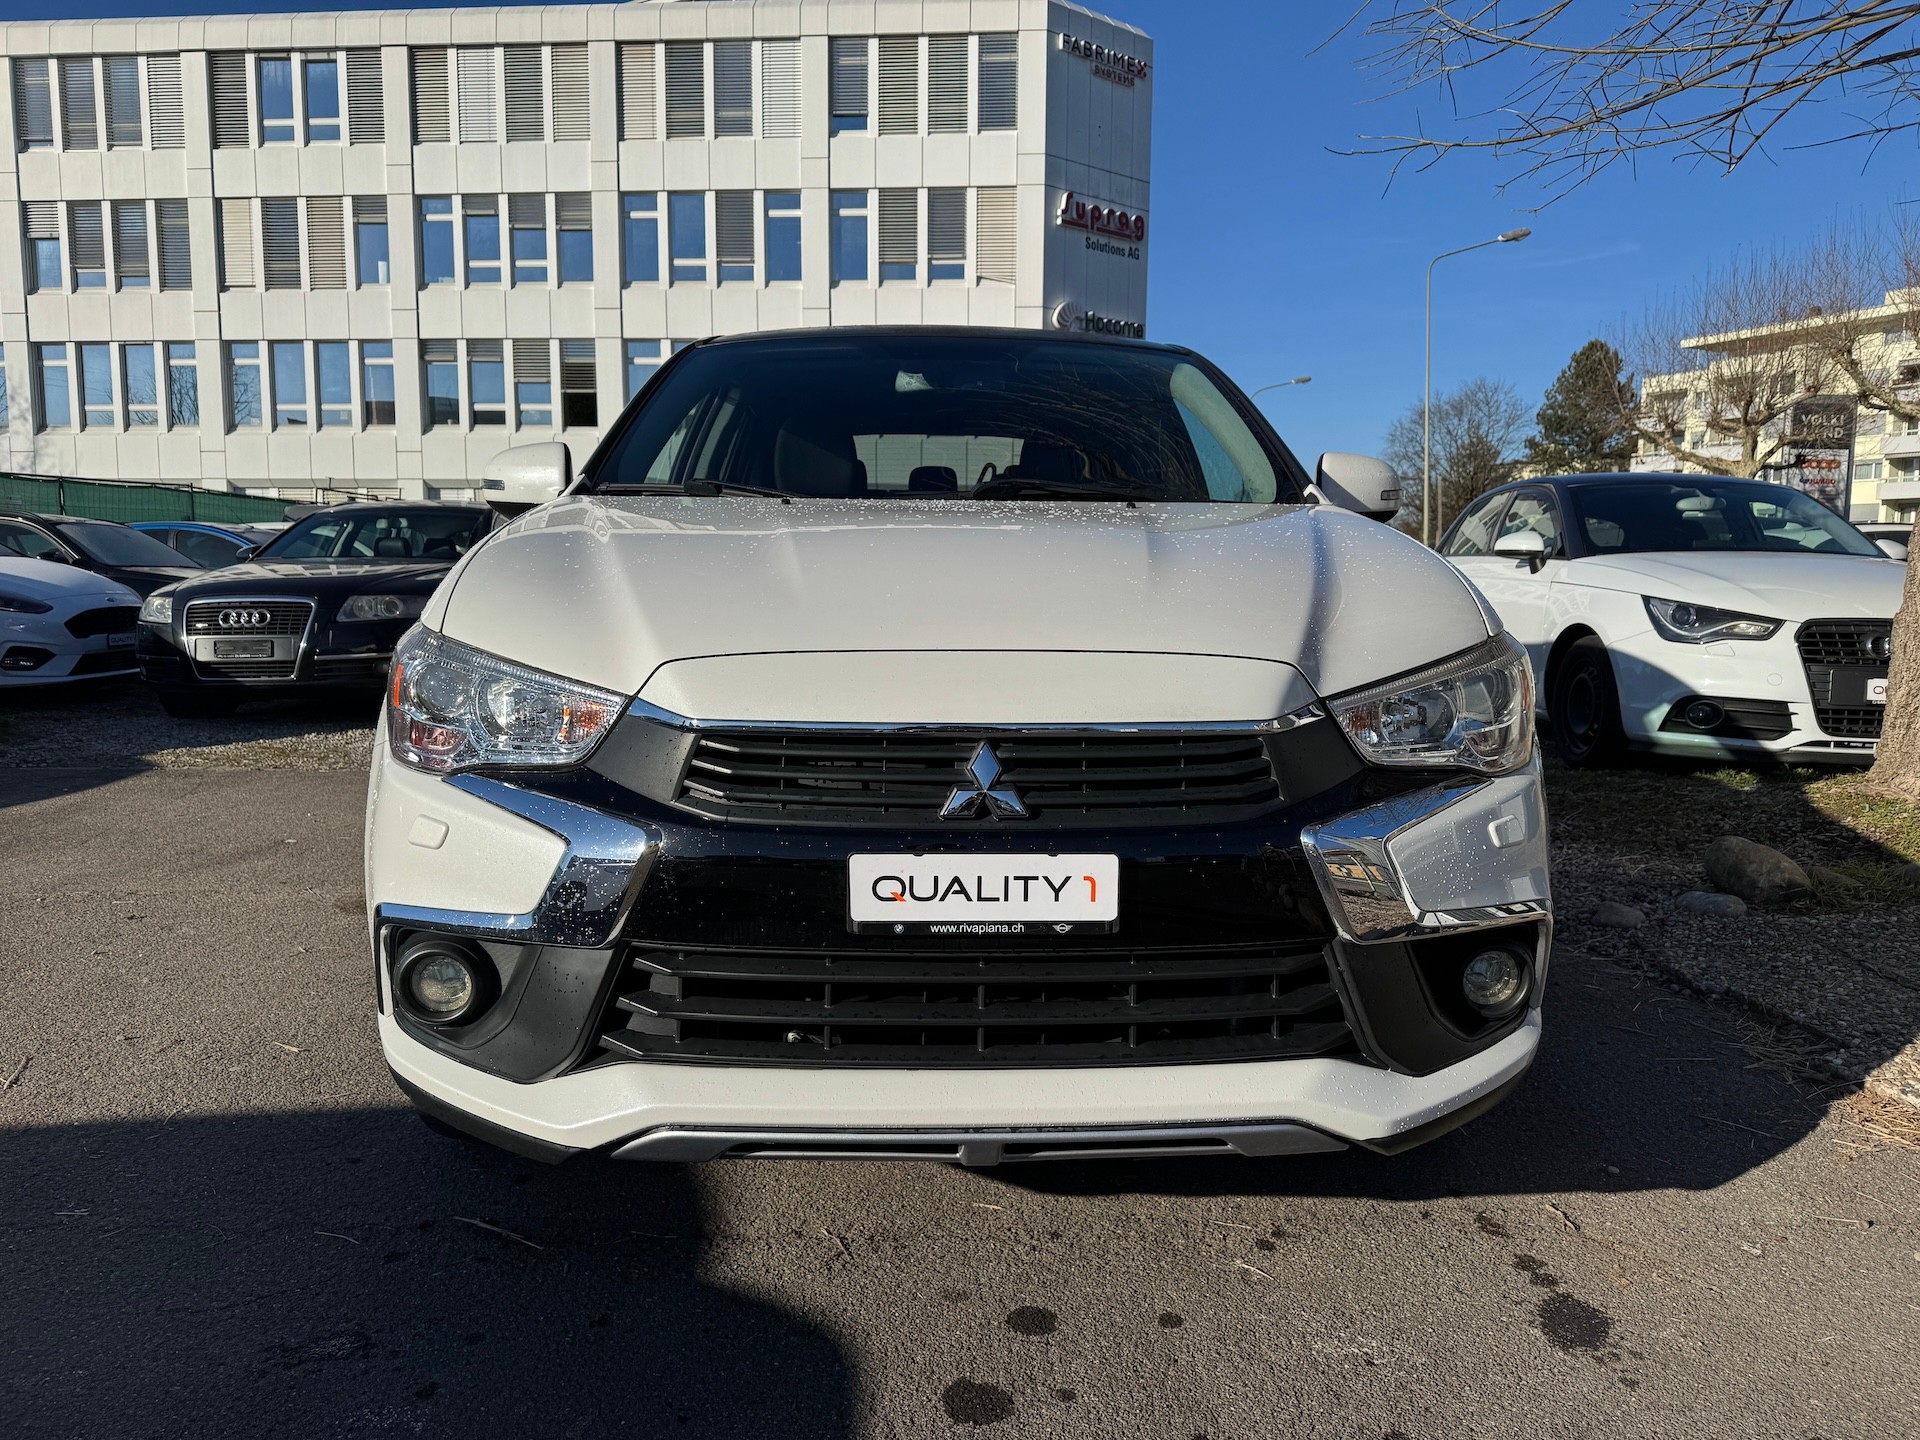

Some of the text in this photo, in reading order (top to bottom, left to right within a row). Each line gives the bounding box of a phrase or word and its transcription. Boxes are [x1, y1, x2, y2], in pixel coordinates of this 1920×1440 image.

[1059, 32, 1147, 78] FABRIMEX
[1057, 191, 1145, 242] Suprag
[1085, 236, 1140, 261] Solutions AG
[1084, 310, 1144, 339] Hocoma
[871, 875, 1097, 902] QUALITY 1
[930, 923, 1025, 935] www.rivapiana.ch
